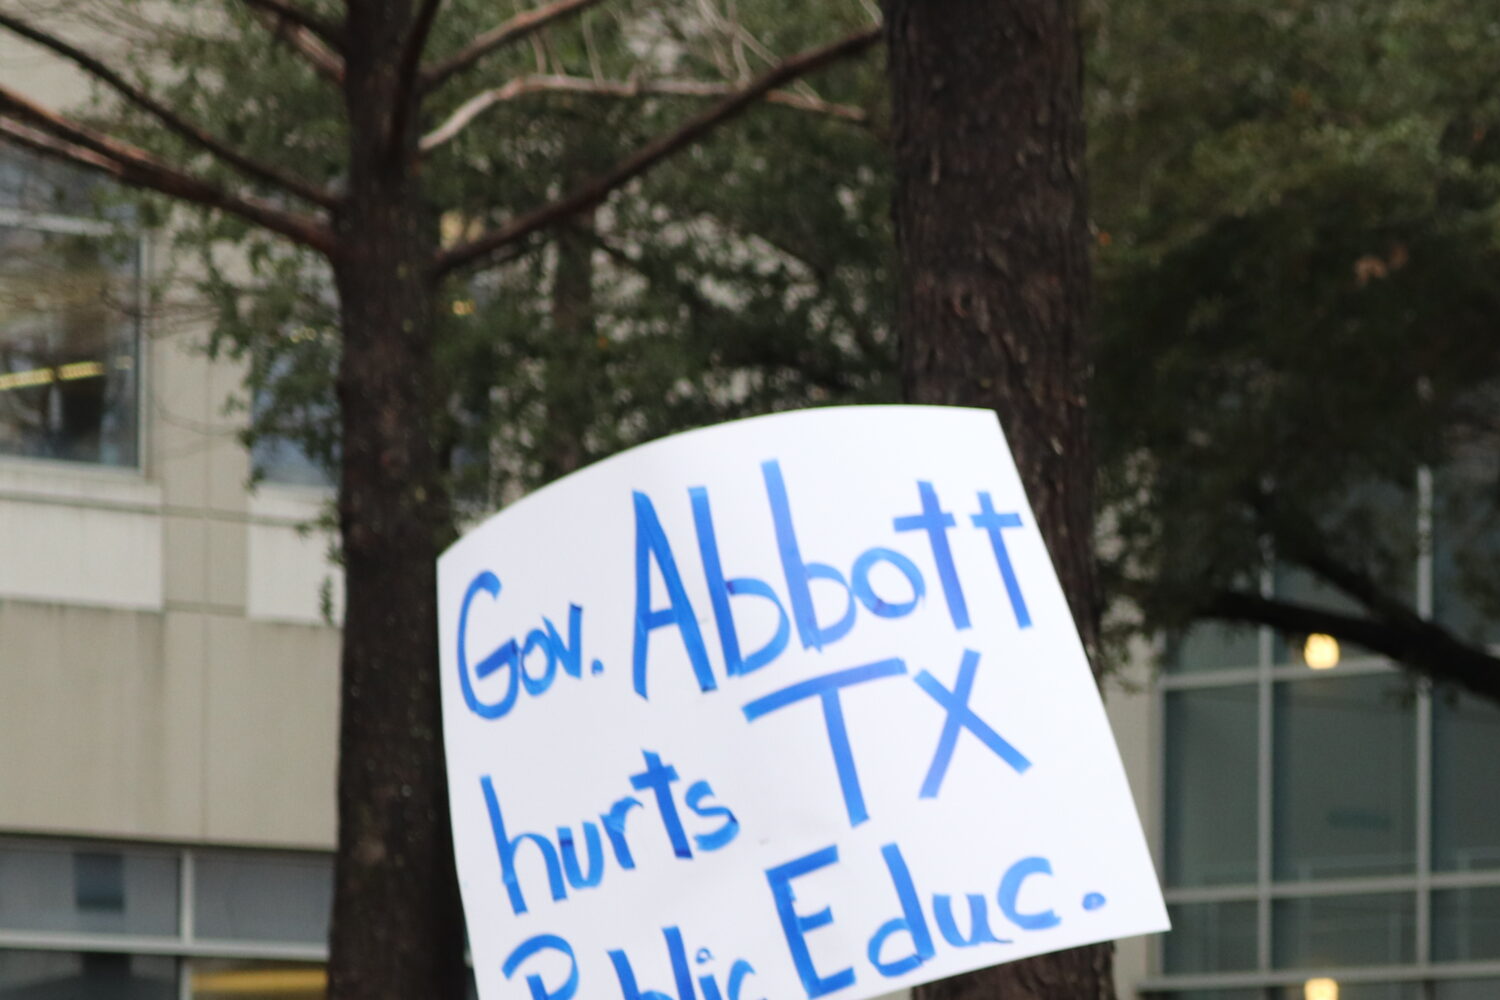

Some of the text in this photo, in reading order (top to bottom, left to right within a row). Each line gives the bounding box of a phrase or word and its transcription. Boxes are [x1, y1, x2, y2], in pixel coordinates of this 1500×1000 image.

[457, 459, 1034, 720] Gov. Abbott
[480, 649, 1033, 915] hurts TX
[765, 844, 1107, 1000] Educ.
